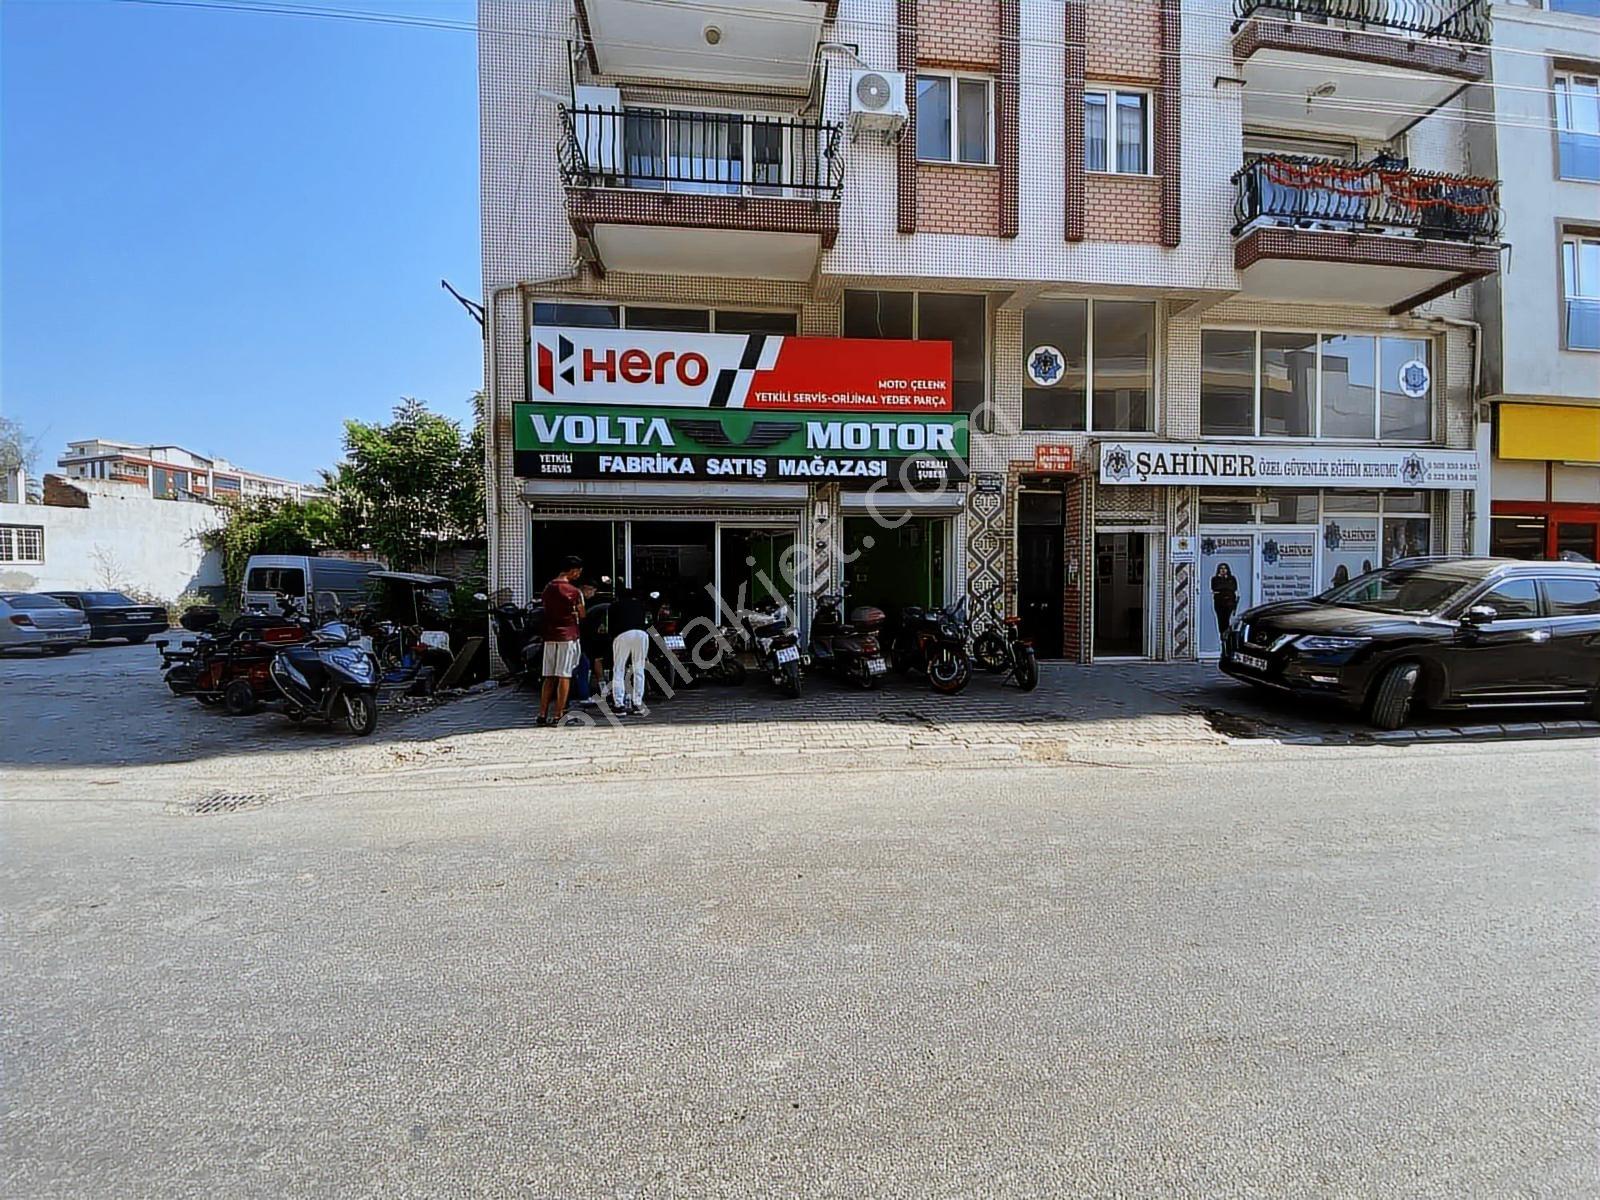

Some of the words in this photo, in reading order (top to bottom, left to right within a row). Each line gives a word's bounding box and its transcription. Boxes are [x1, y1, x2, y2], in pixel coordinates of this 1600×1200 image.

[583, 348, 709, 387] Hero
[878, 380, 908, 390] MOTO
[910, 380, 947, 392] ÇELENK
[754, 391, 791, 403] YETKİLİ
[880, 395, 912, 405] YEDEK
[913, 396, 946, 408] PARÇA
[529, 414, 676, 447] VOLTA
[806, 421, 956, 451] MOTOR
[539, 453, 573, 463] YETKİLİ
[599, 453, 695, 474] FABRİKA
[706, 458, 767, 477] SATIŞ
[778, 455, 888, 477] MAĞAZASI
[1136, 446, 1256, 482] ŞAHİNER
[1259, 457, 1282, 476] ÖZEL
[1283, 458, 1329, 477] GÜVENLİK
[1330, 458, 1361, 477] EĞİTİM
[1362, 463, 1399, 478] KURUMU
[541, 464, 572, 474] SERVİS
